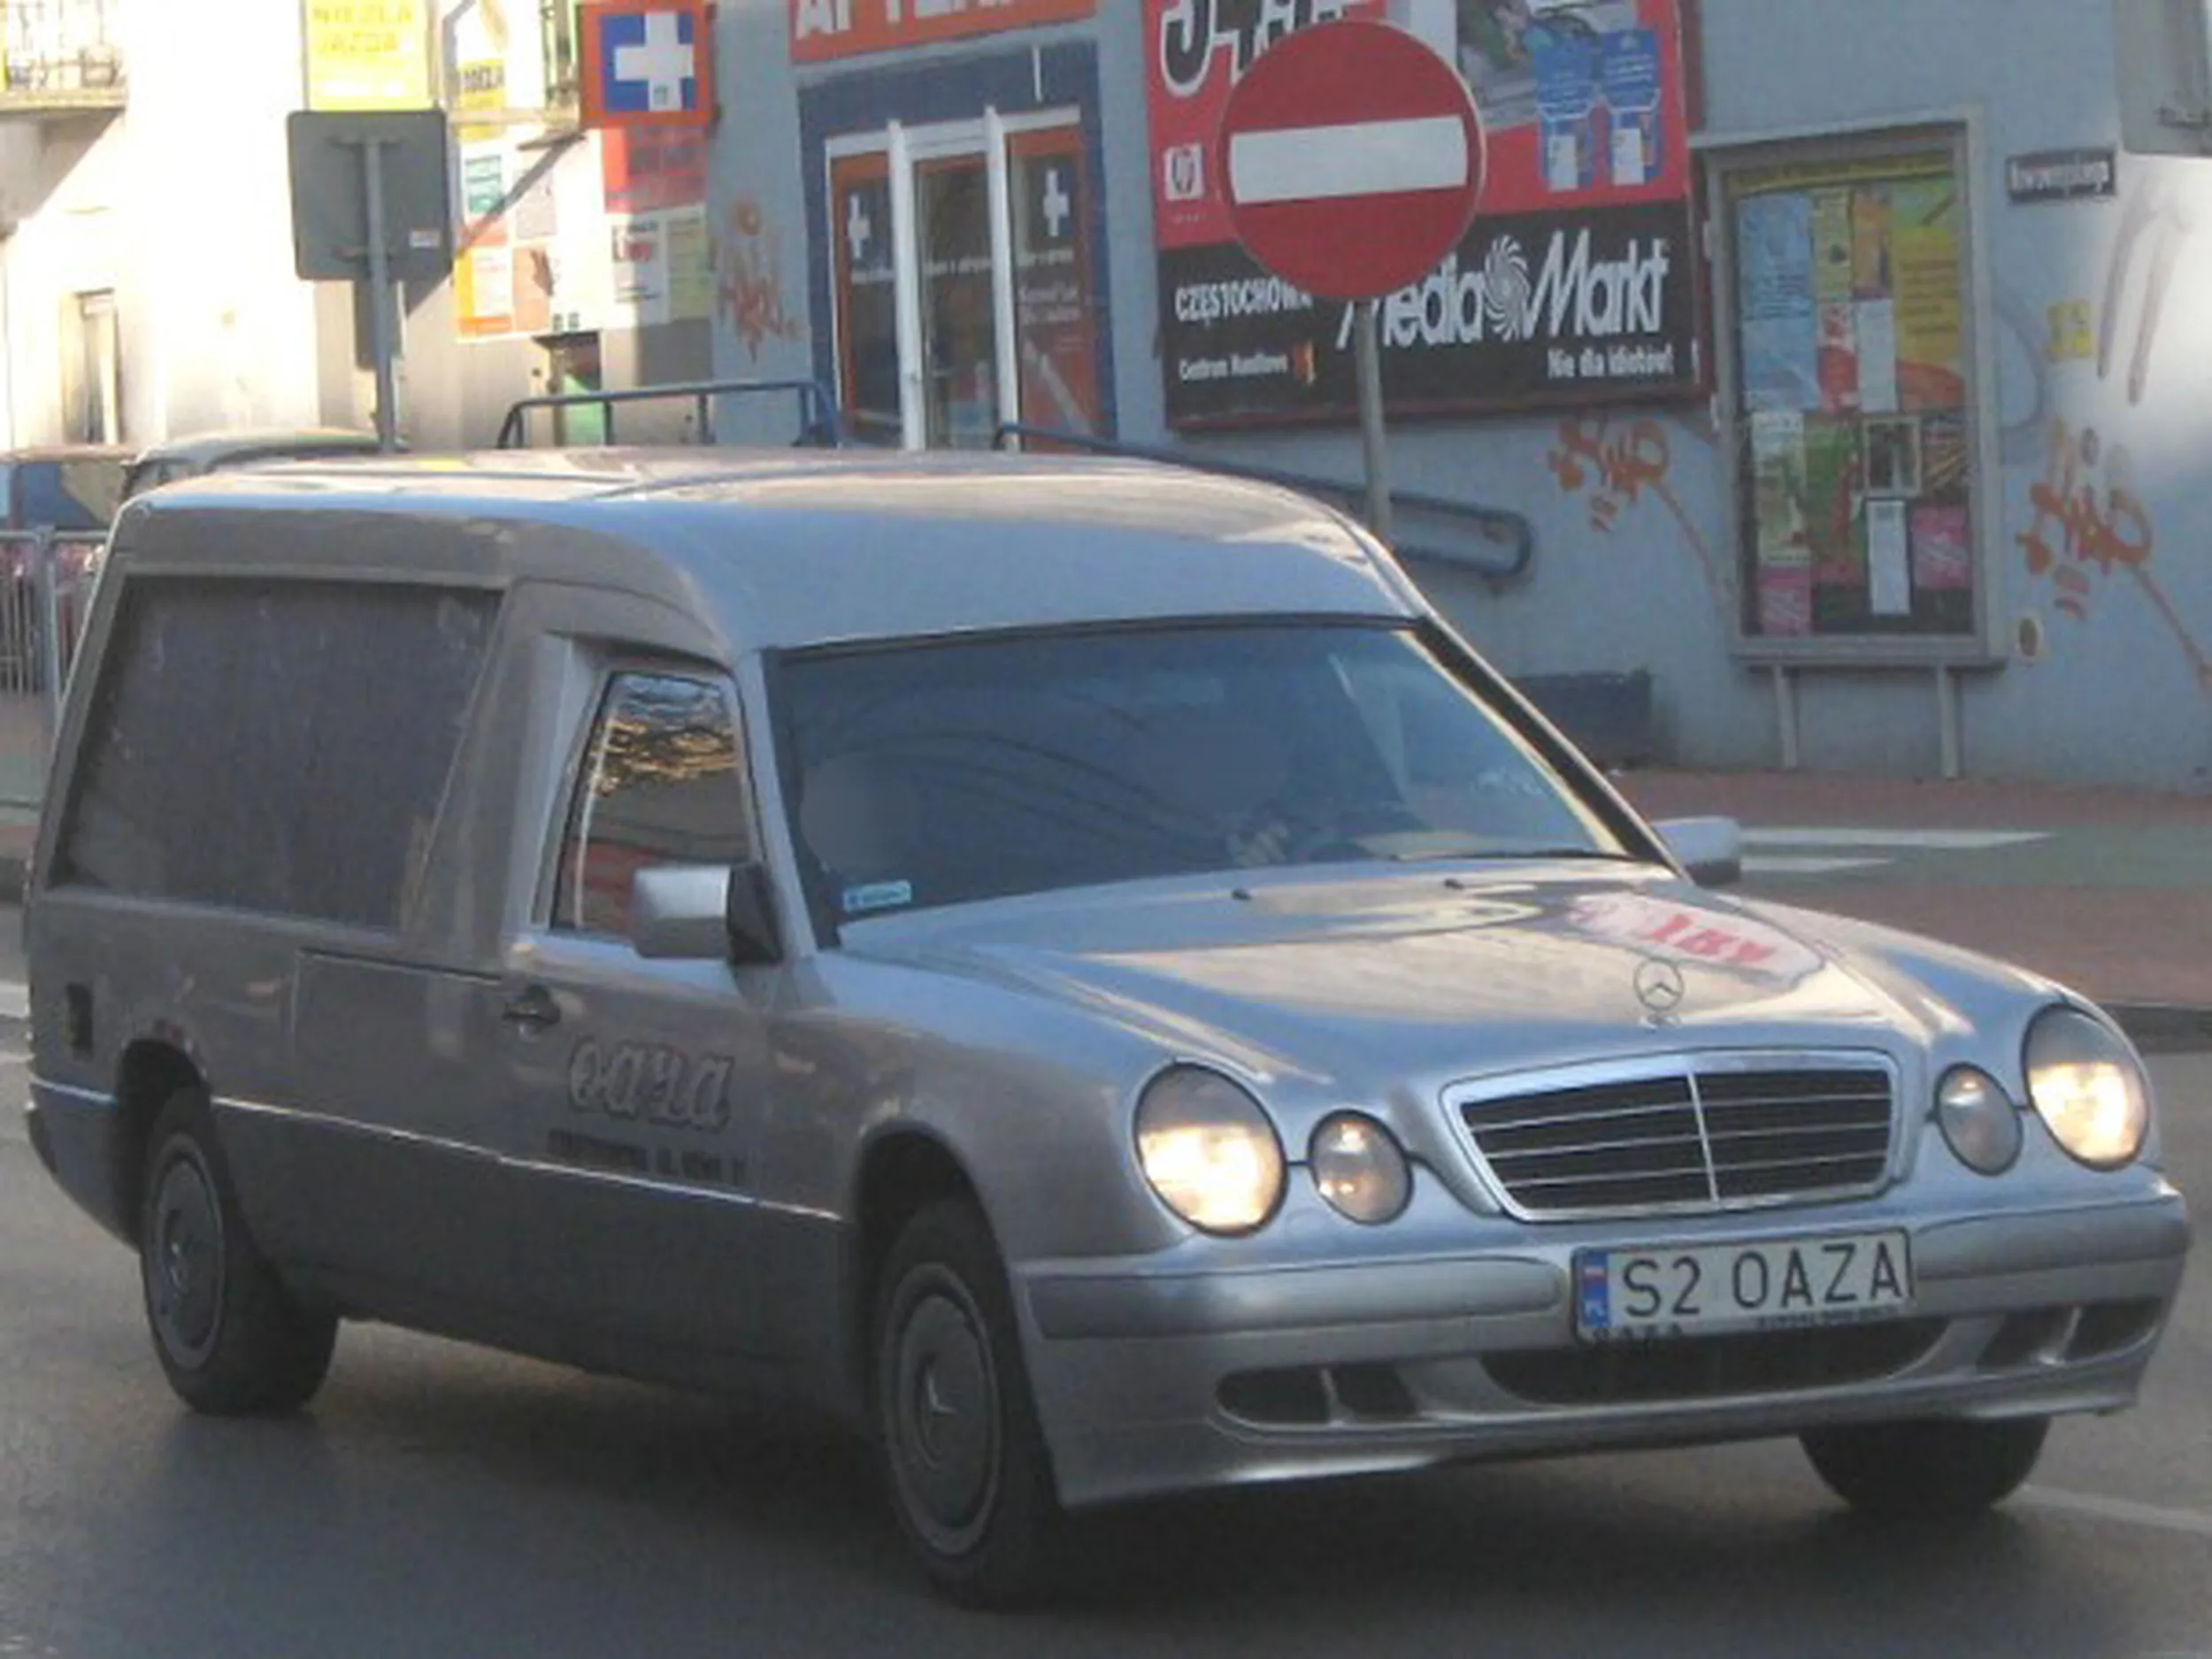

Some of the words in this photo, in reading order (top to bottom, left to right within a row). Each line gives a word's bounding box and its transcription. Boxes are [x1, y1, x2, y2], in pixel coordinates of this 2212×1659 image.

[1522, 227, 1670, 338] Markt
[1623, 1256, 1701, 1317] S2
[1732, 1240, 1903, 1310] OAZA
